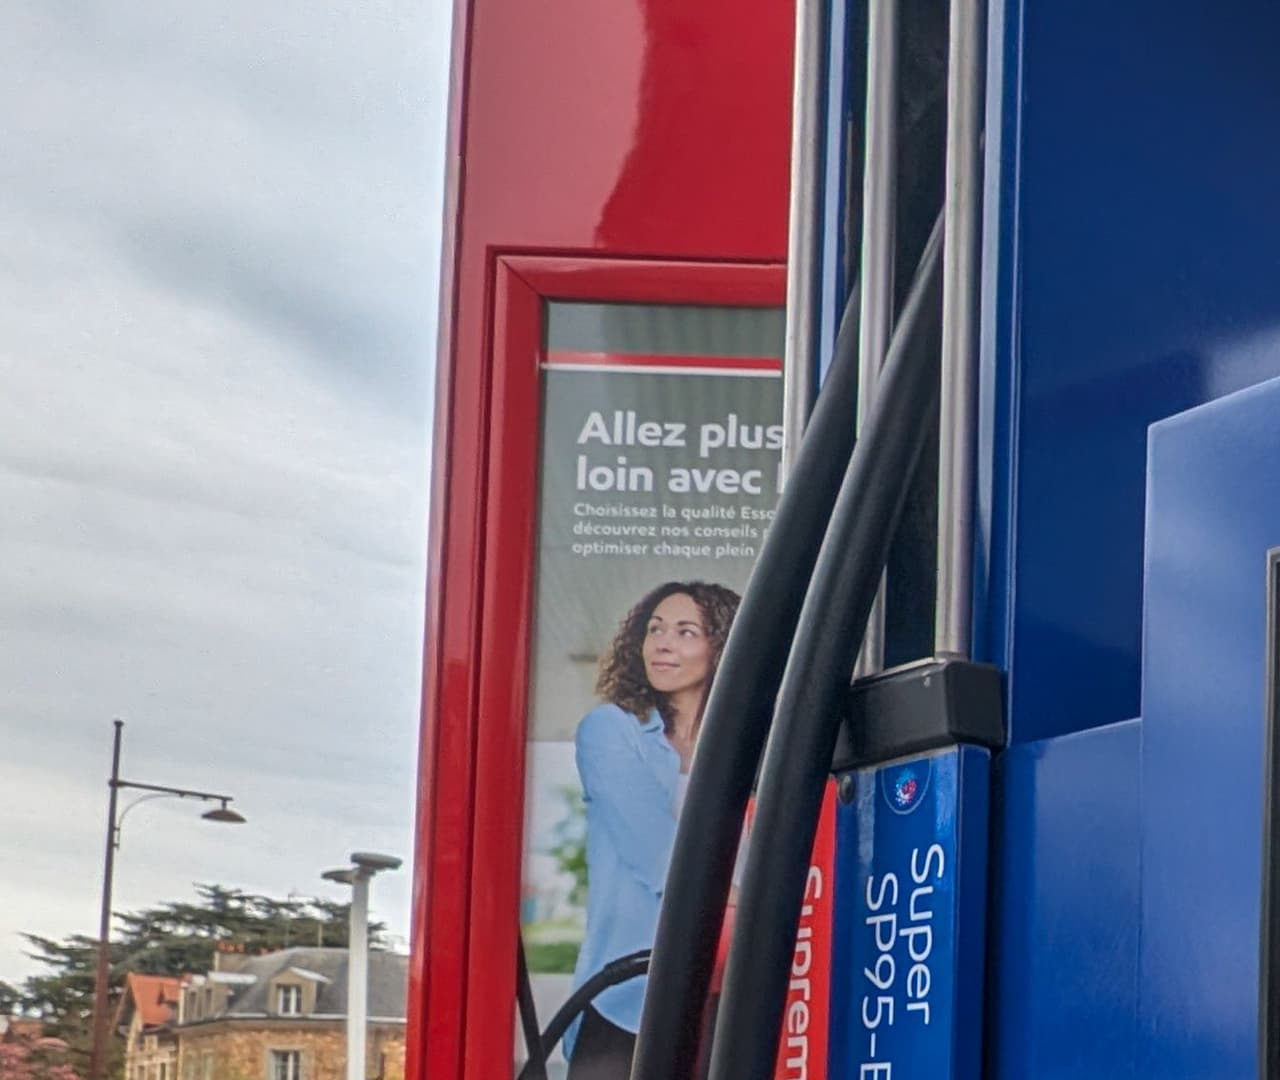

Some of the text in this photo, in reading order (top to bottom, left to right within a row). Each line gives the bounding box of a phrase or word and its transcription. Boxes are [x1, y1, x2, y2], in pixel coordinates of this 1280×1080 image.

[577, 411, 784, 457] Allez plus
[577, 455, 653, 492] loin
[668, 463, 760, 494] avec
[574, 503, 657, 518] Choisissez
[663, 504, 675, 518] la
[681, 504, 736, 521] qualité
[573, 521, 656, 537] découvrez
[661, 525, 689, 537] nos
[694, 524, 757, 538] conseils
[572, 540, 753, 558] optimiser chaque plein
[899, 843, 945, 1024] Super
